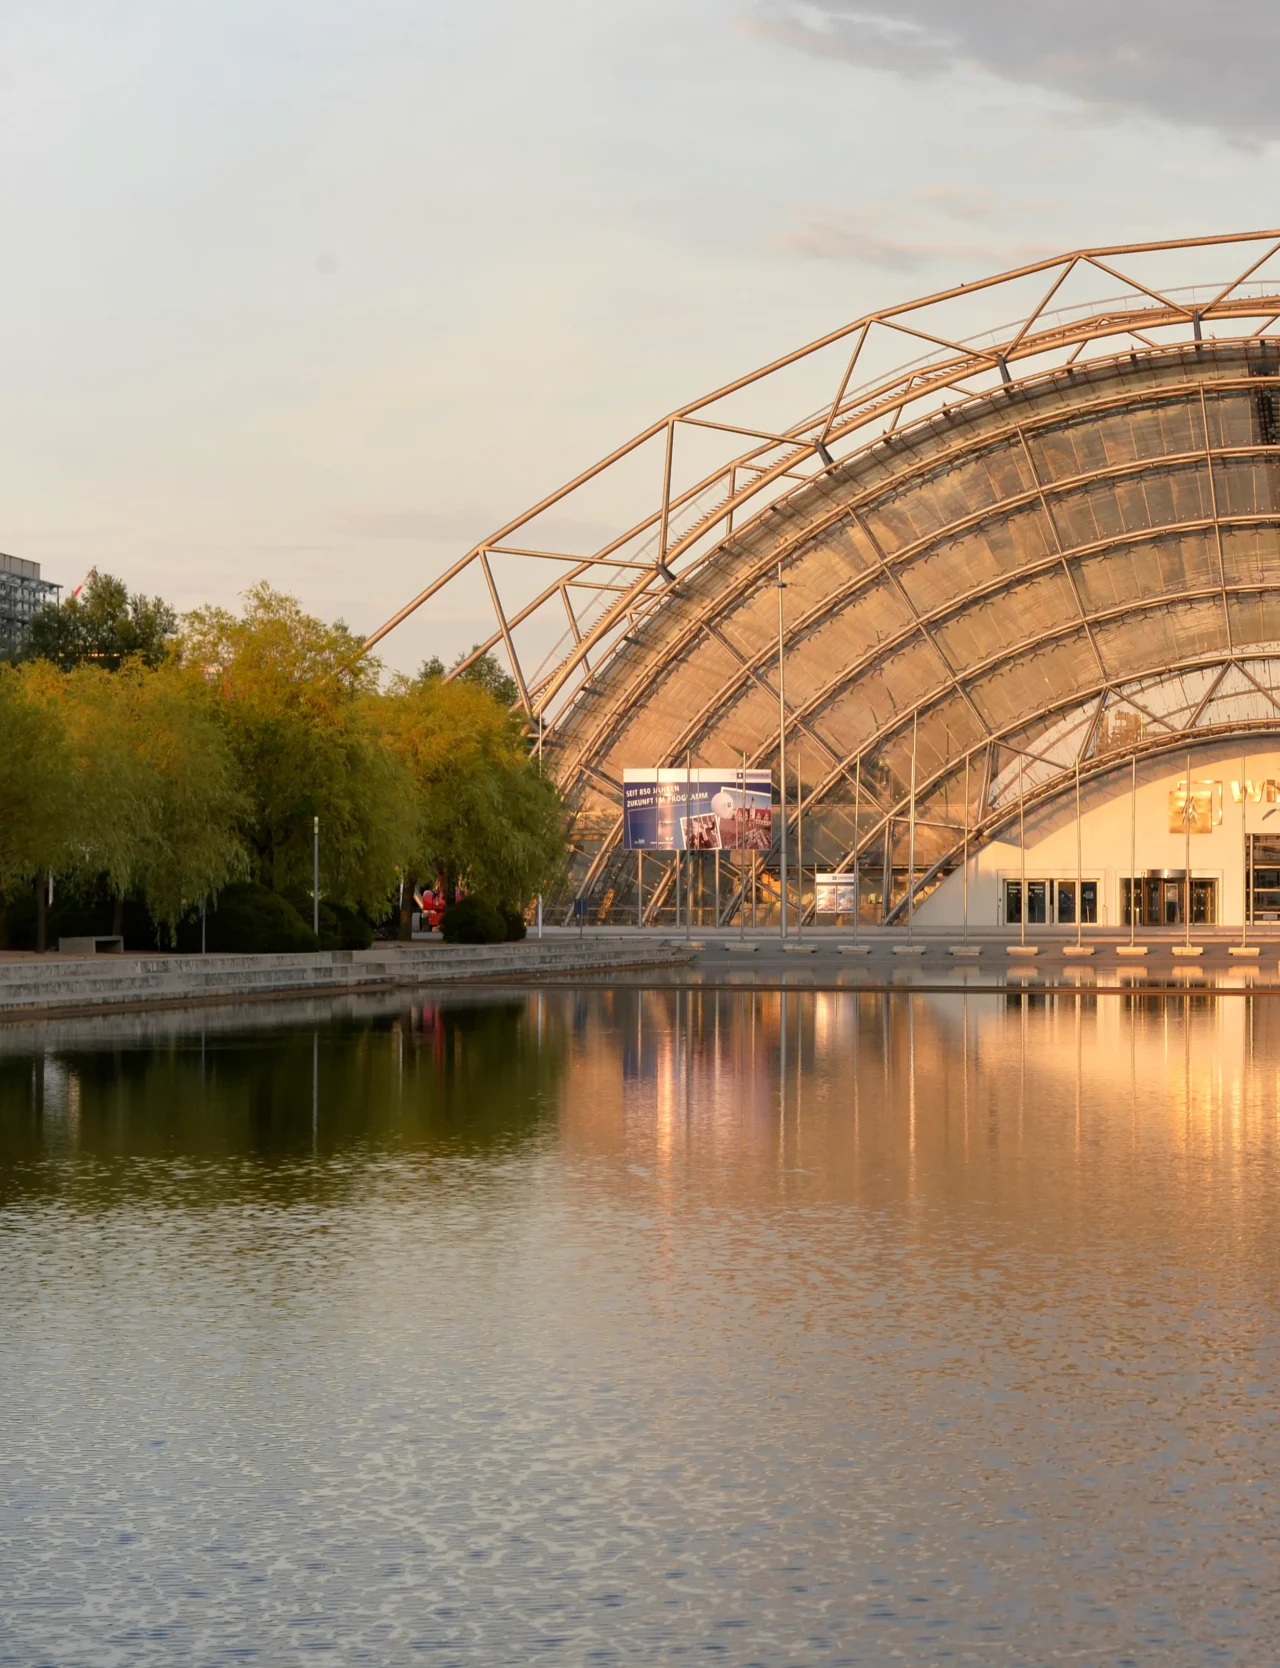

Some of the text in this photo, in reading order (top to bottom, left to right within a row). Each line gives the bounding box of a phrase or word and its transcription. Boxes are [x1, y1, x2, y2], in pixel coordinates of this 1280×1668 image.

[626, 788, 638, 797] SEIT
[639, 787, 651, 795] 850
[626, 797, 654, 807] ZUKUNFT
[667, 792, 709, 803] PROGAMM
